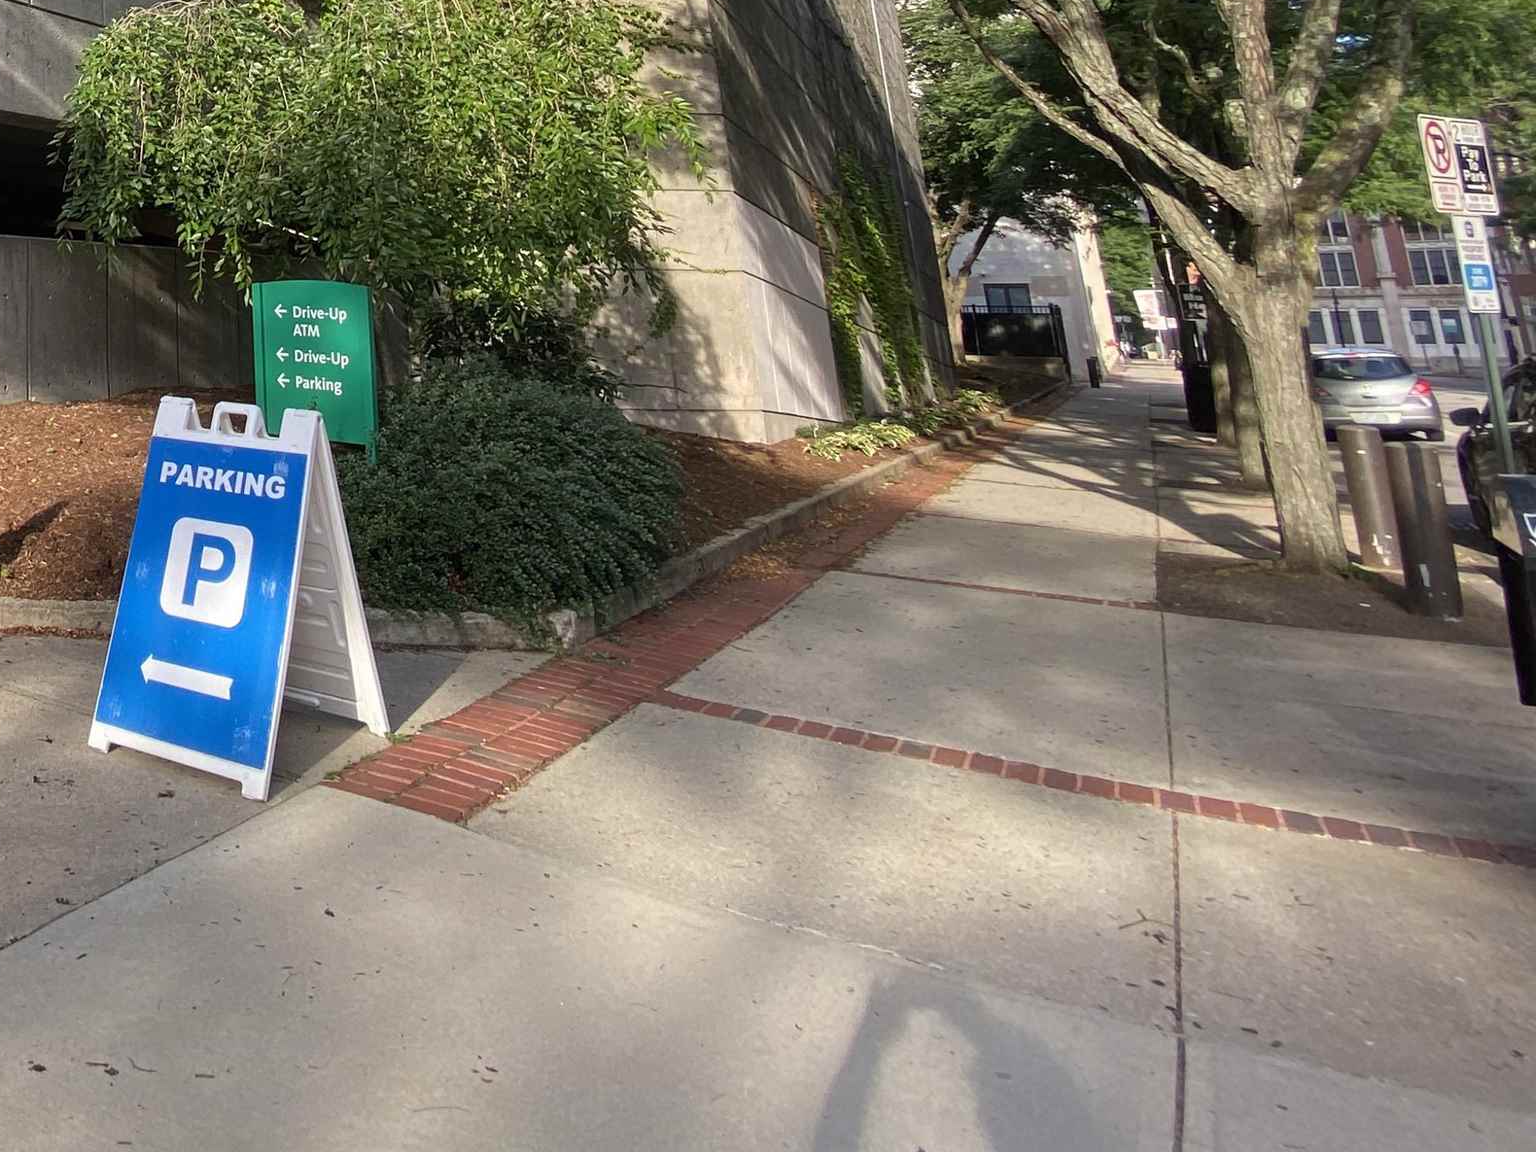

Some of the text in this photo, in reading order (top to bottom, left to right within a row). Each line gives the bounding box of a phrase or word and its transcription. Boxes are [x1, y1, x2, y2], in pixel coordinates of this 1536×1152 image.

[1460, 146, 1480, 162] Pay
[1465, 158, 1480, 171] To
[1462, 169, 1489, 183] Park
[292, 305, 348, 325] Drive-Up
[293, 323, 320, 338] ATM
[294, 349, 350, 369] Drive-Up
[295, 375, 343, 396] Parking
[159, 460, 287, 500] PARKING
[181, 531, 237, 607] P
